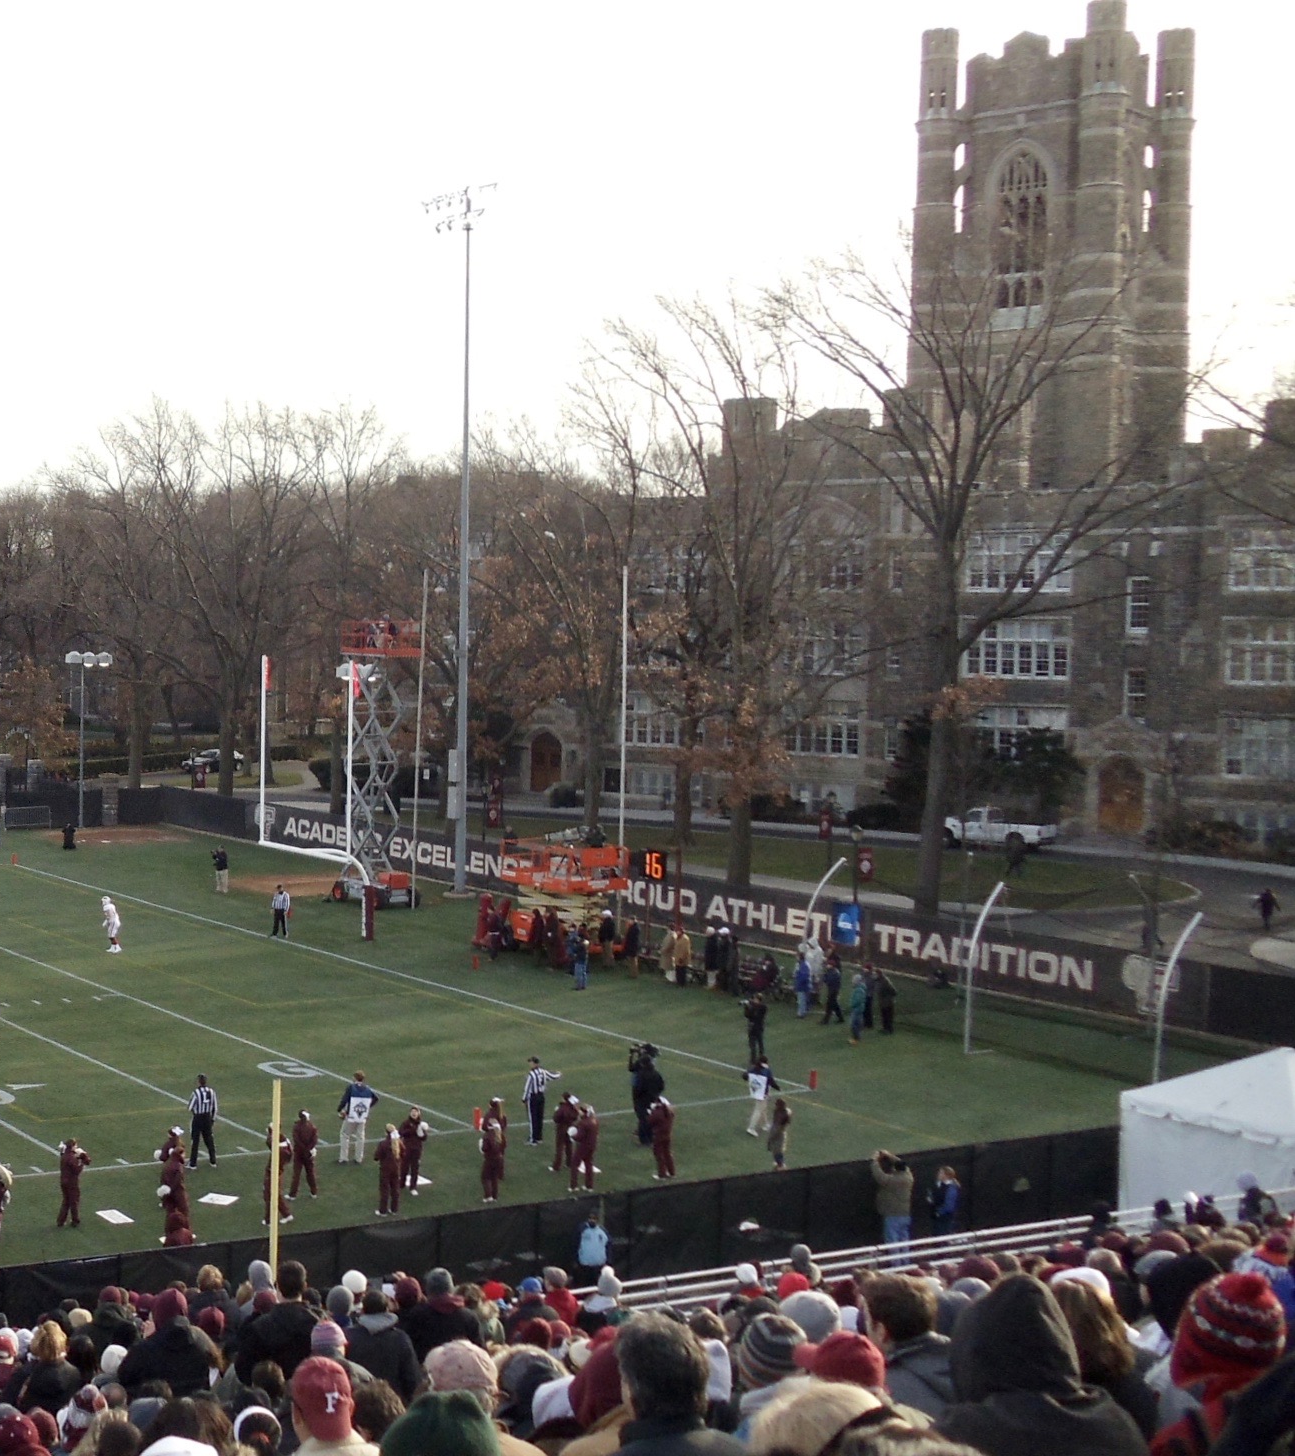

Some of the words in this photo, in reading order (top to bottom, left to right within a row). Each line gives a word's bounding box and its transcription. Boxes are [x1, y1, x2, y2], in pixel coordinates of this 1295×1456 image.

[646, 853, 662, 879] 16
[874, 924, 1093, 990] TRADITION
[255, 1060, 325, 1078] G
[325, 1391, 340, 1413] F
